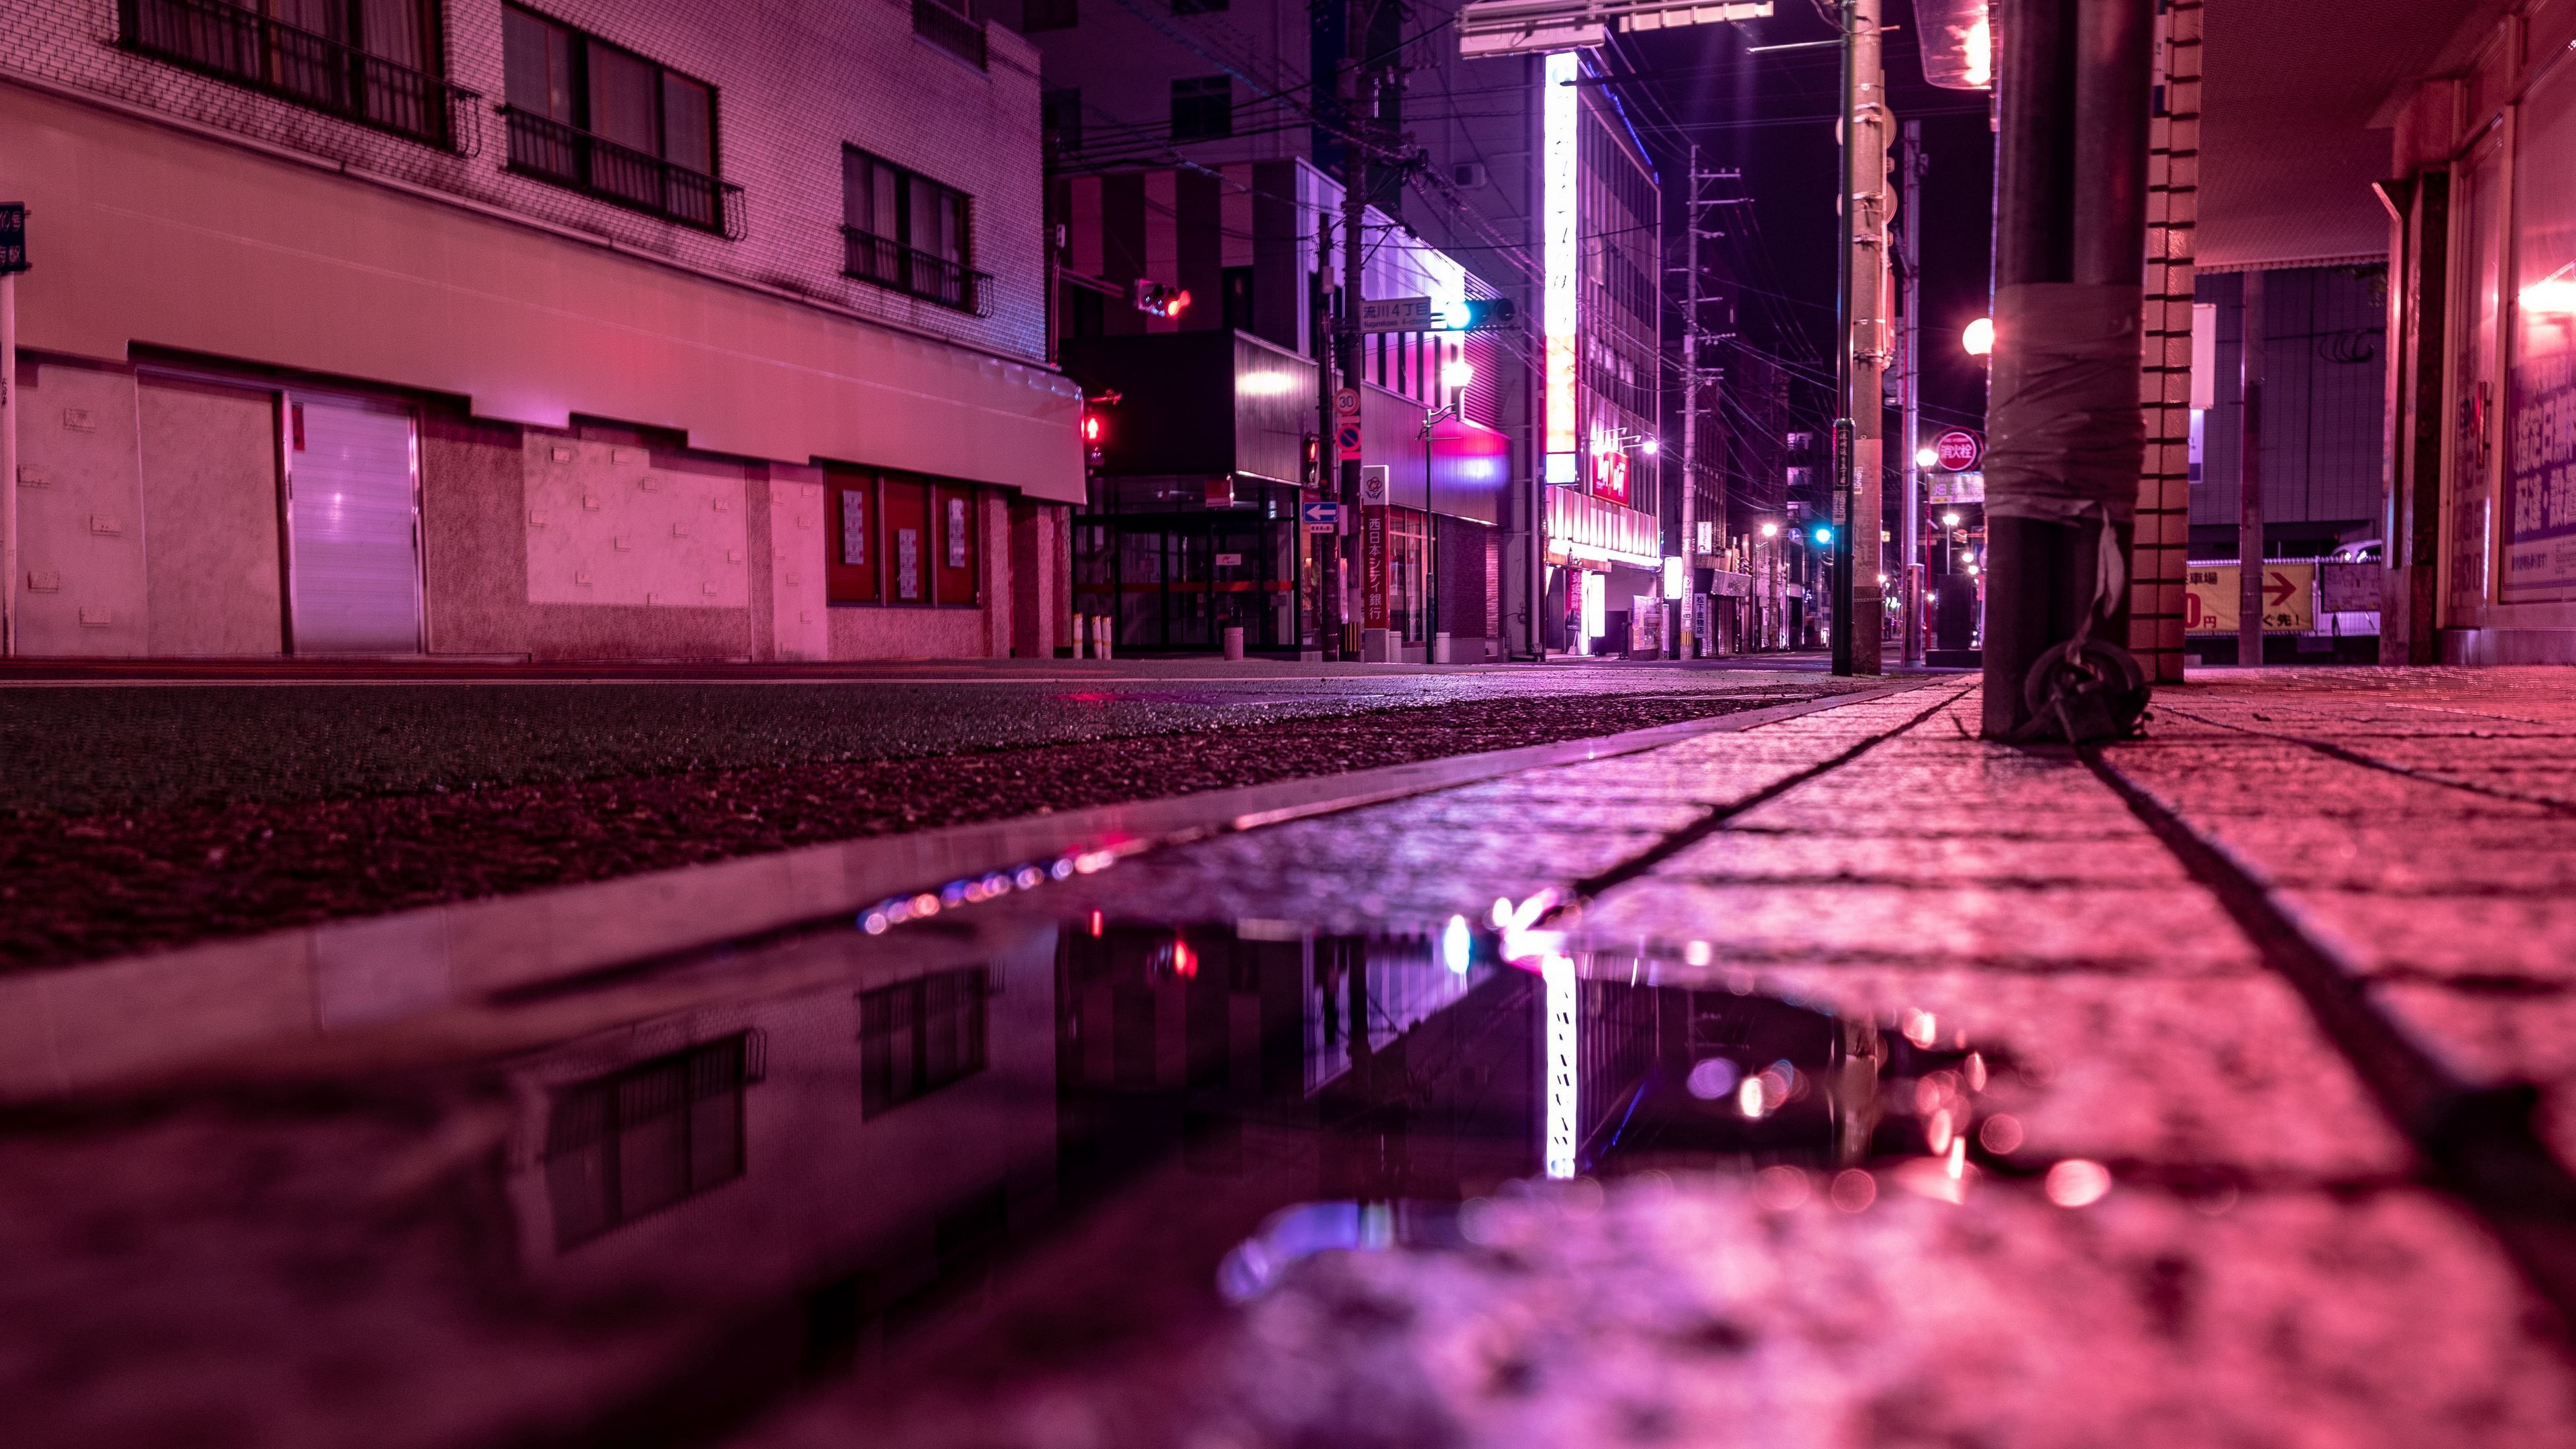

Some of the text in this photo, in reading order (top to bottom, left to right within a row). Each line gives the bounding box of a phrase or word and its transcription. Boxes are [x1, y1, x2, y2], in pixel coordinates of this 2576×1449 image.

[1363, 303, 1428, 318] 流川4丁目
[1339, 395, 1354, 408] 30
[1941, 444, 1972, 459] 消火栓
[1368, 519, 1382, 620] 西日本シティ銀行
[2186, 572, 2218, 585] 車場
[1697, 596, 1705, 635] 松下金物店
